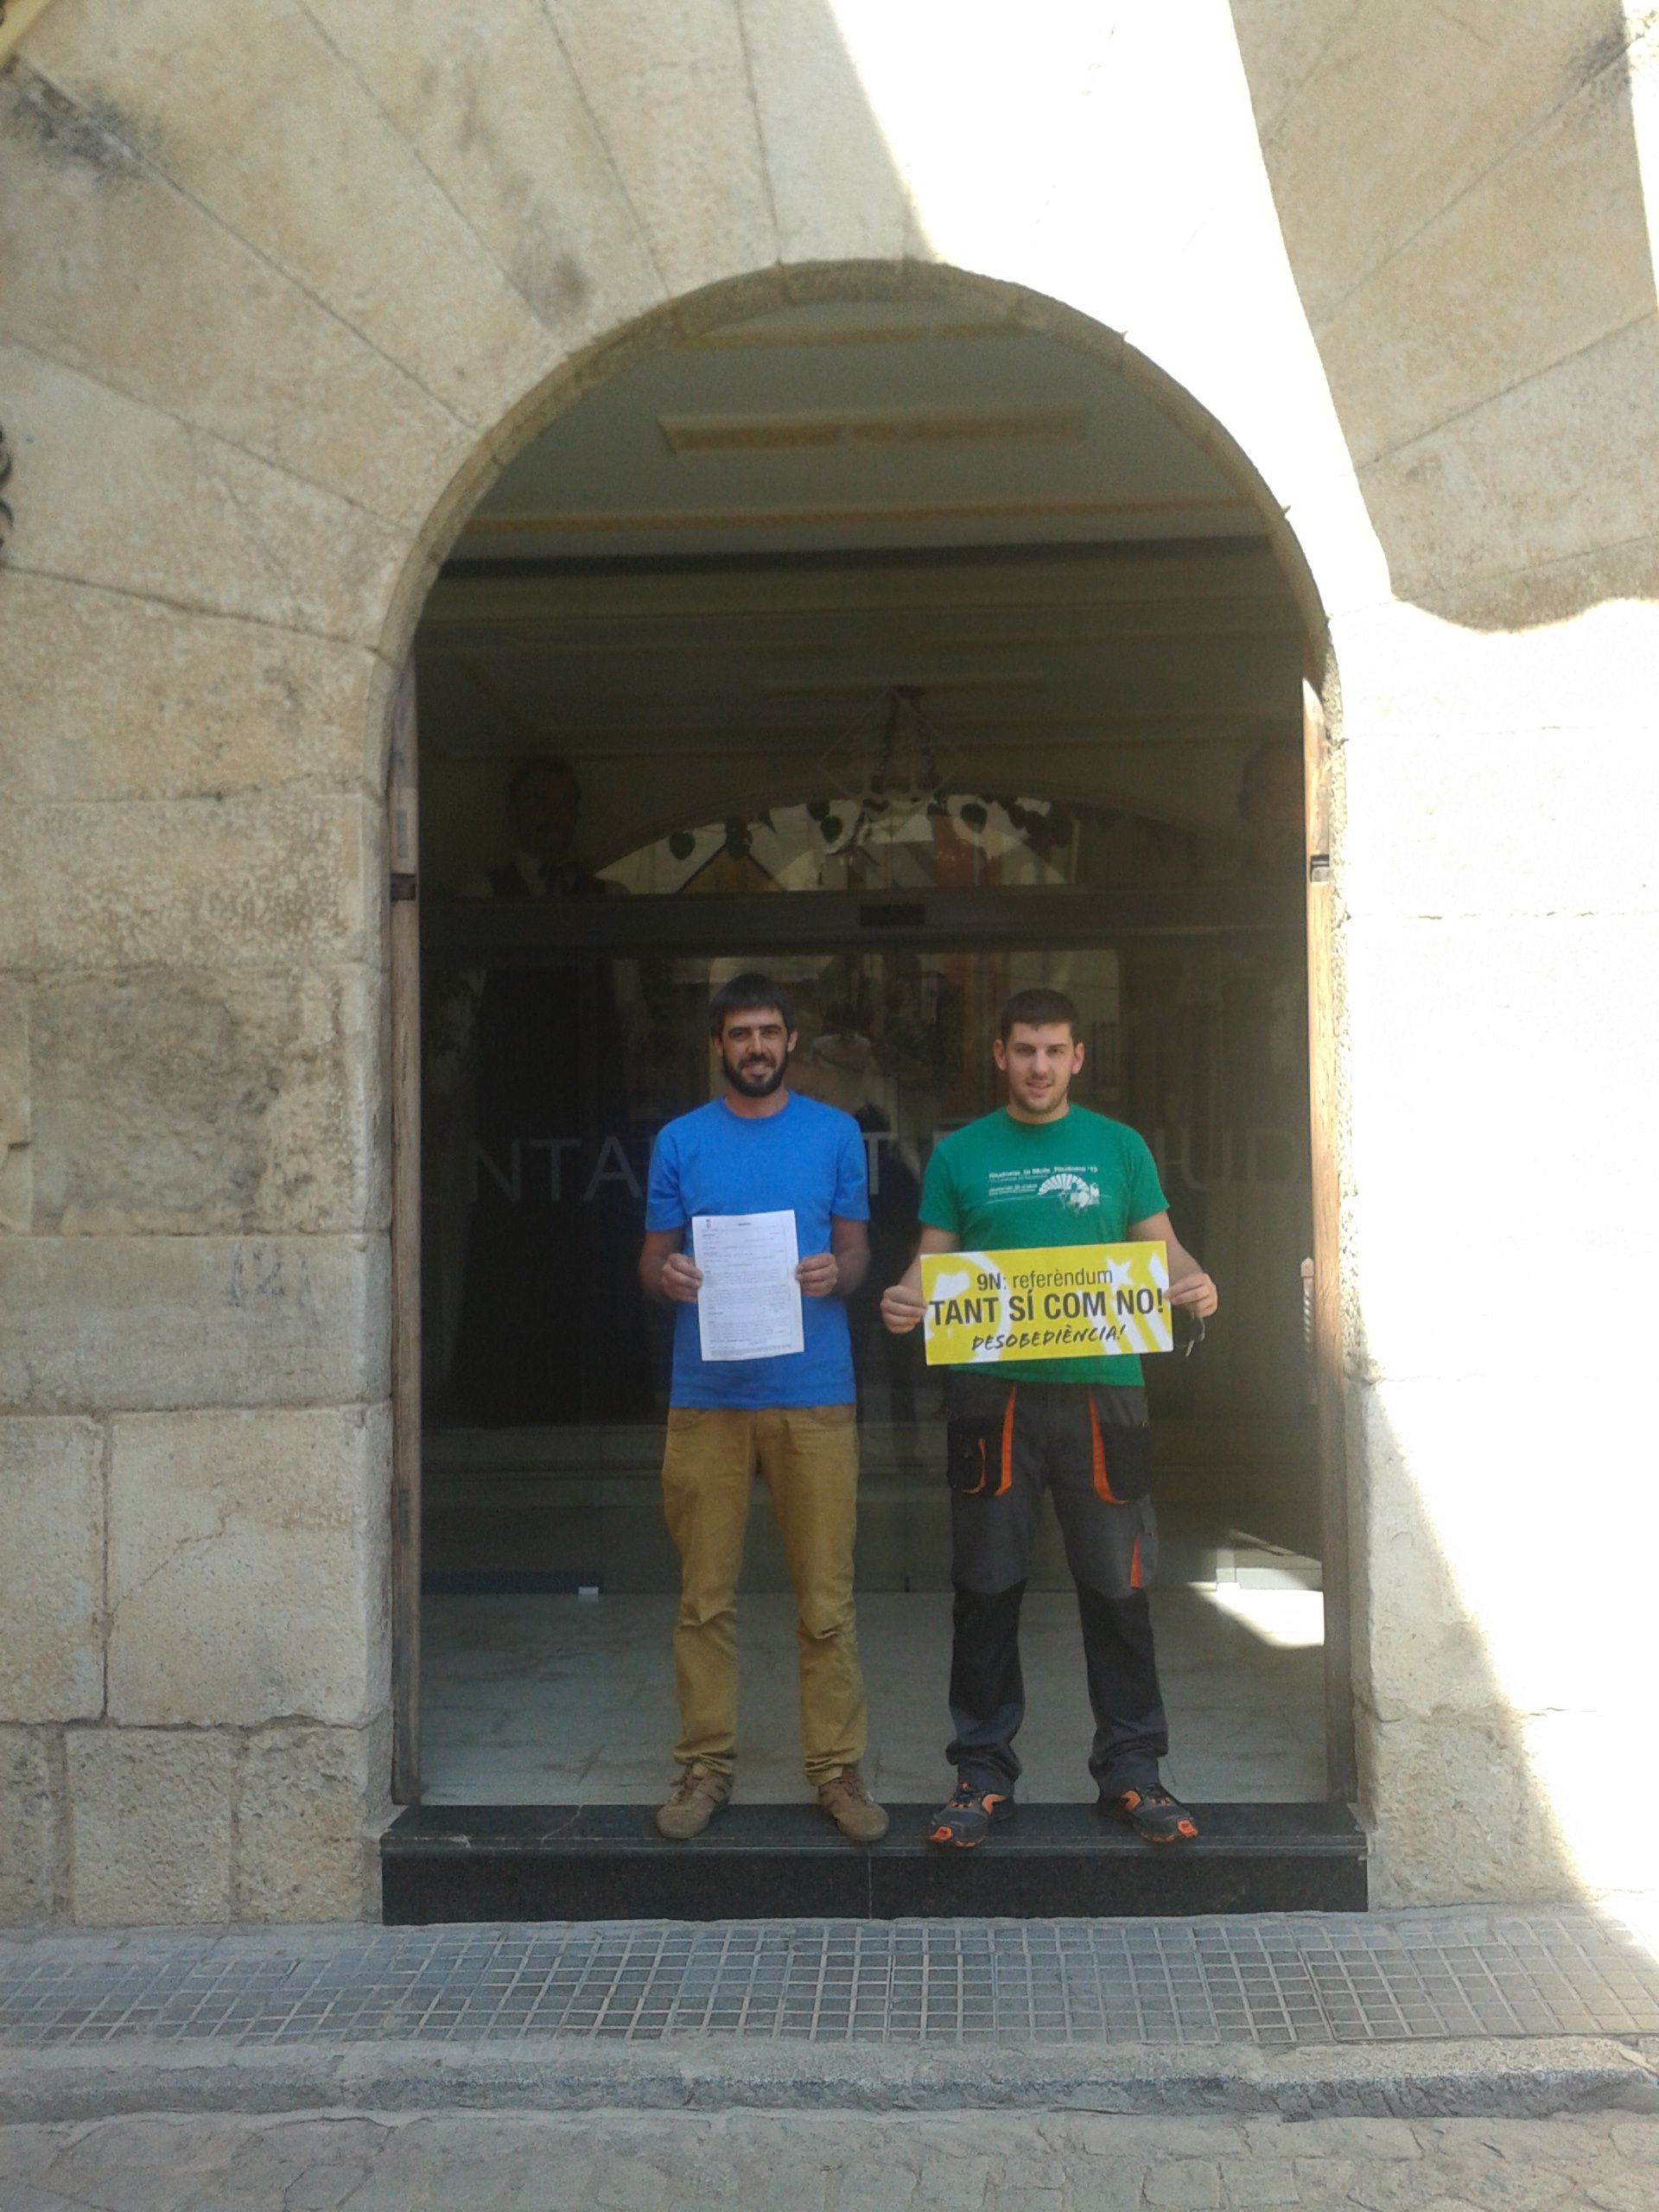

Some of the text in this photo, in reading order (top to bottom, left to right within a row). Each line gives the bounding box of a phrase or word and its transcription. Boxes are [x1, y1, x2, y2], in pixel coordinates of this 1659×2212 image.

[976, 1268, 1114, 1291] 9N: referèndum
[929, 1287, 1165, 1326] TANT SÍ COM NO!
[971, 1324, 1127, 1351] DESOBEDIÈNCIA!
